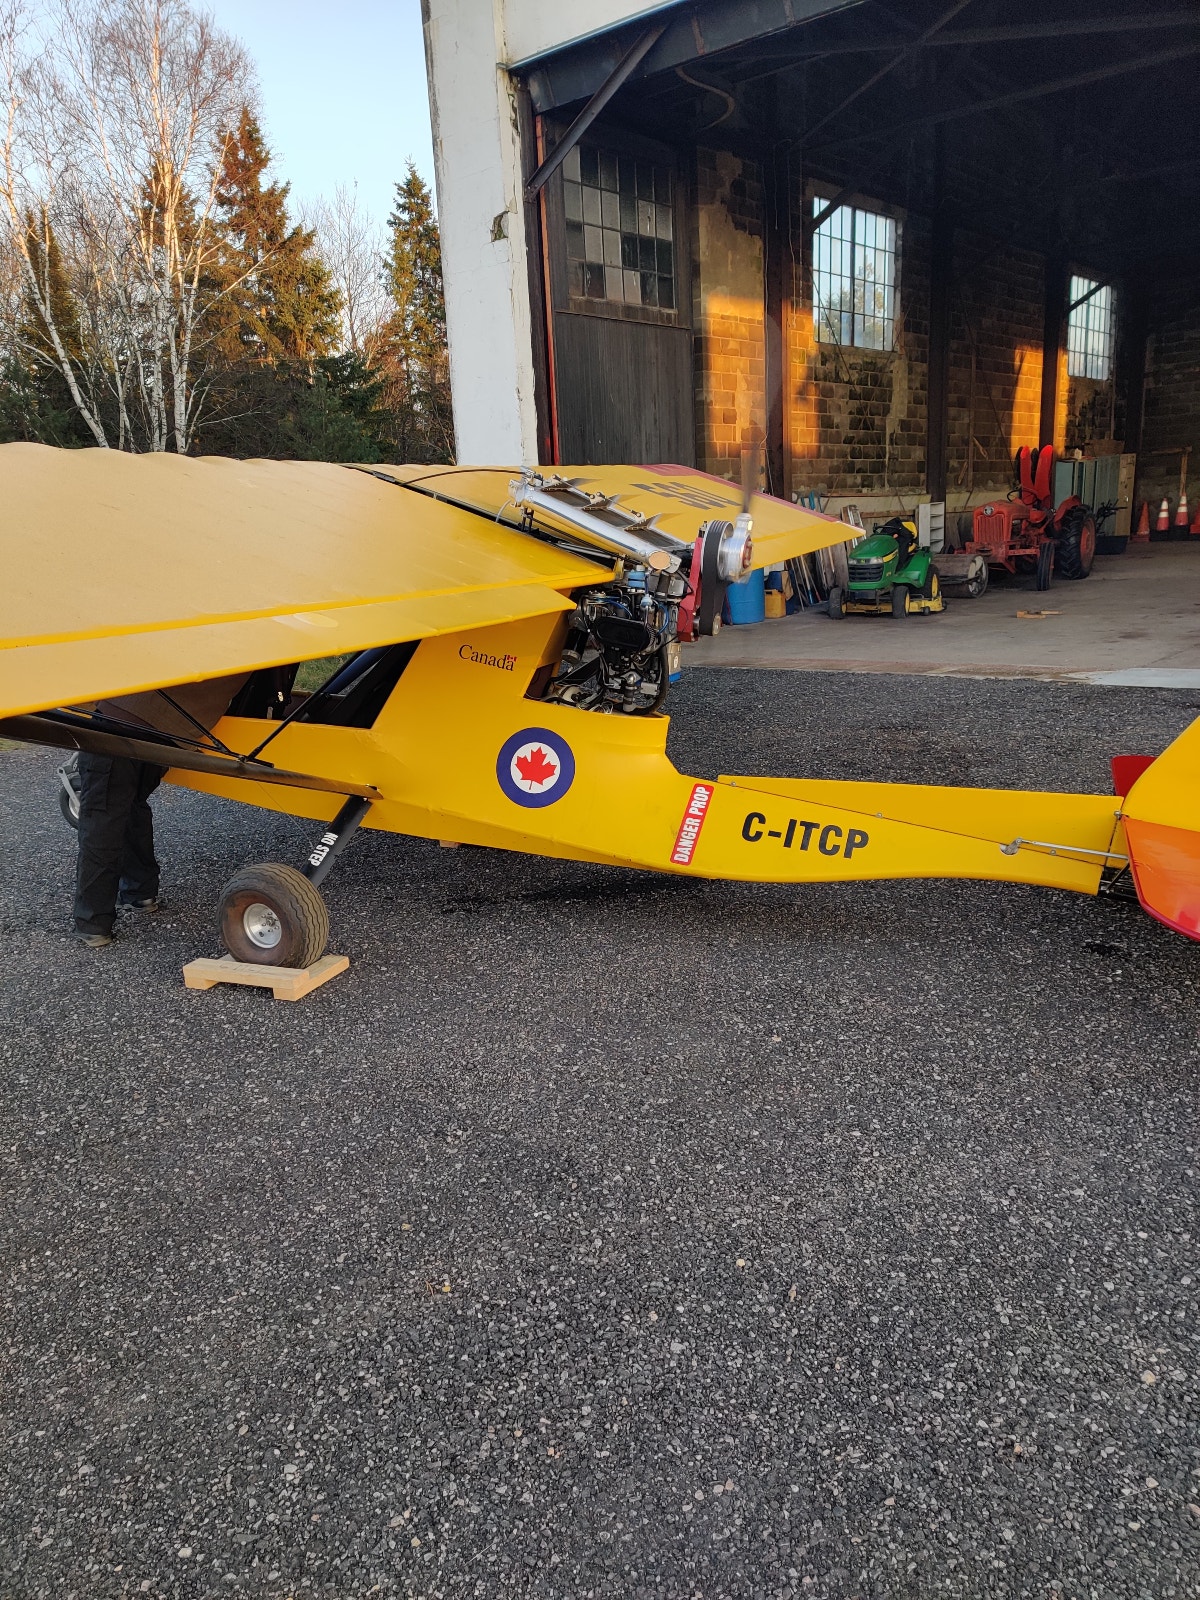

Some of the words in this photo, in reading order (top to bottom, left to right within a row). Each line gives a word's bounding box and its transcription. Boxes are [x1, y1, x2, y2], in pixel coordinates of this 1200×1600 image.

[458, 644, 514, 671] Canada
[673, 817, 701, 863] DANGER
[689, 786, 711, 816] PROP
[741, 811, 870, 859] C-ITCP
[320, 832, 339, 846] NO
[308, 844, 330, 867] STEP
